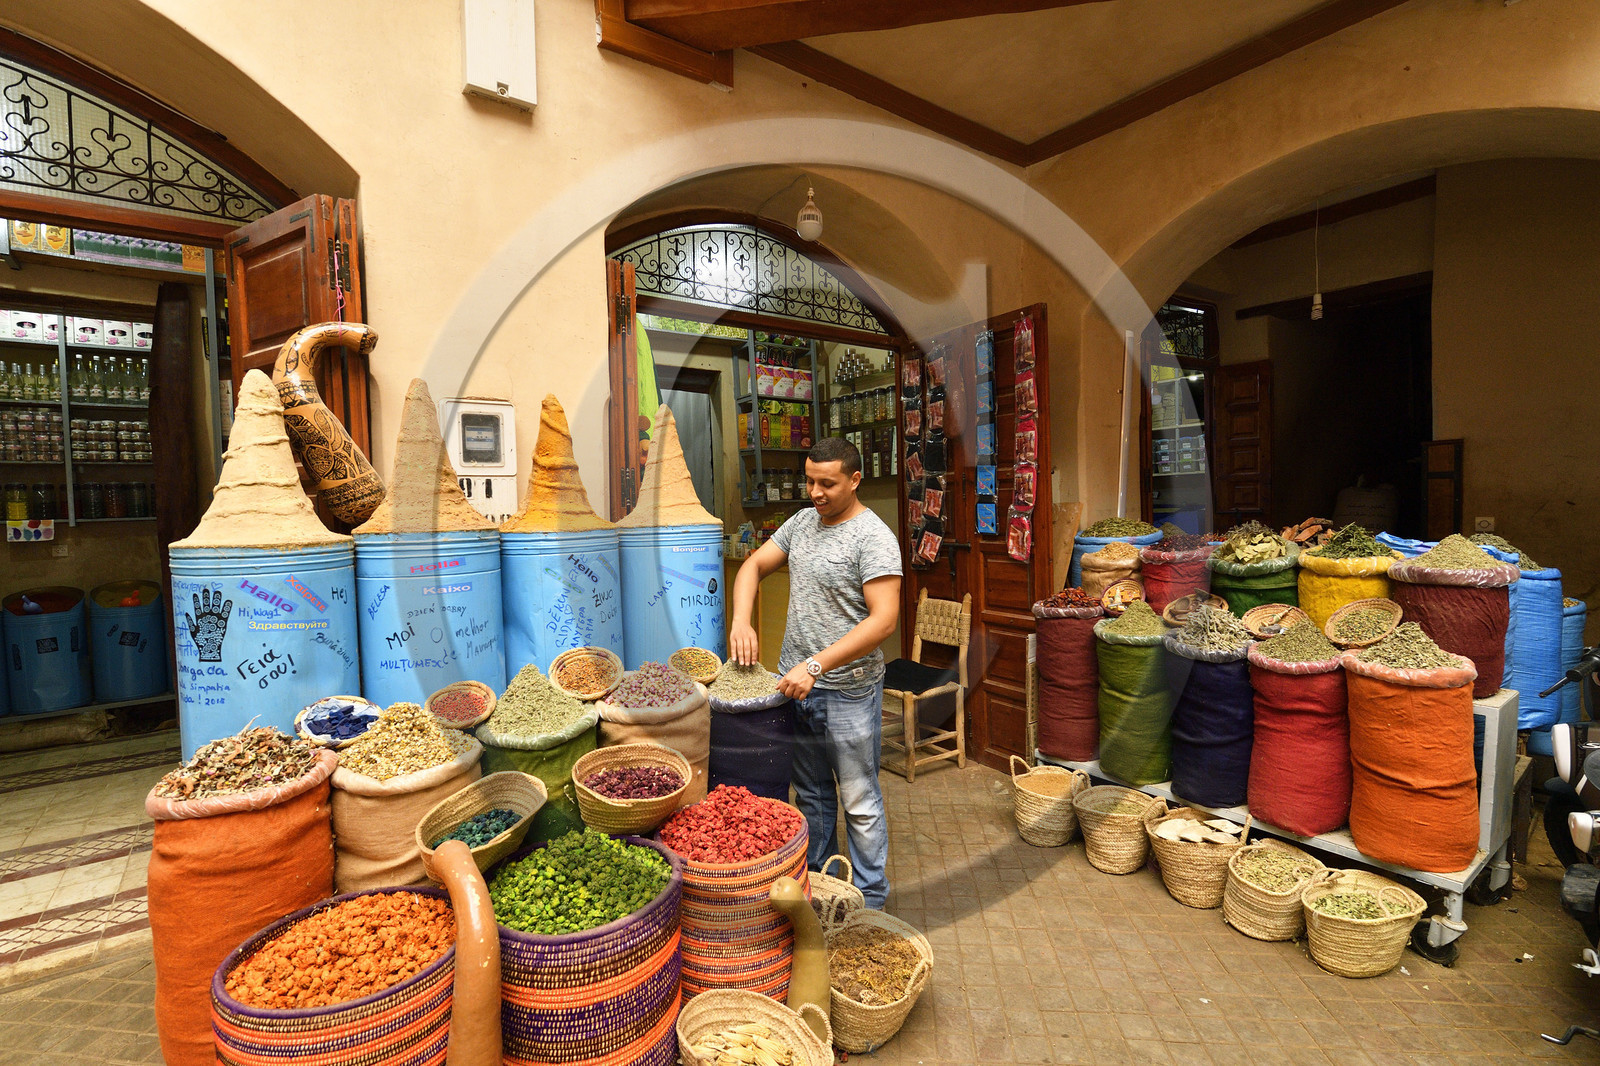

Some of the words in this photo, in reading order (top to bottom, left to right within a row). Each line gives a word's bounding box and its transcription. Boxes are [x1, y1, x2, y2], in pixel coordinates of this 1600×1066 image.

[410, 560, 460, 574] Holla
[568, 554, 598, 583] Hello
[240, 580, 293, 612] Hallo
[331, 586, 347, 604] Hej
[423, 584, 471, 595] Kaixo
[648, 580, 672, 607] LABAS
[680, 594, 722, 608] MIRDITA
[248, 621, 328, 631] Здравствуйте
